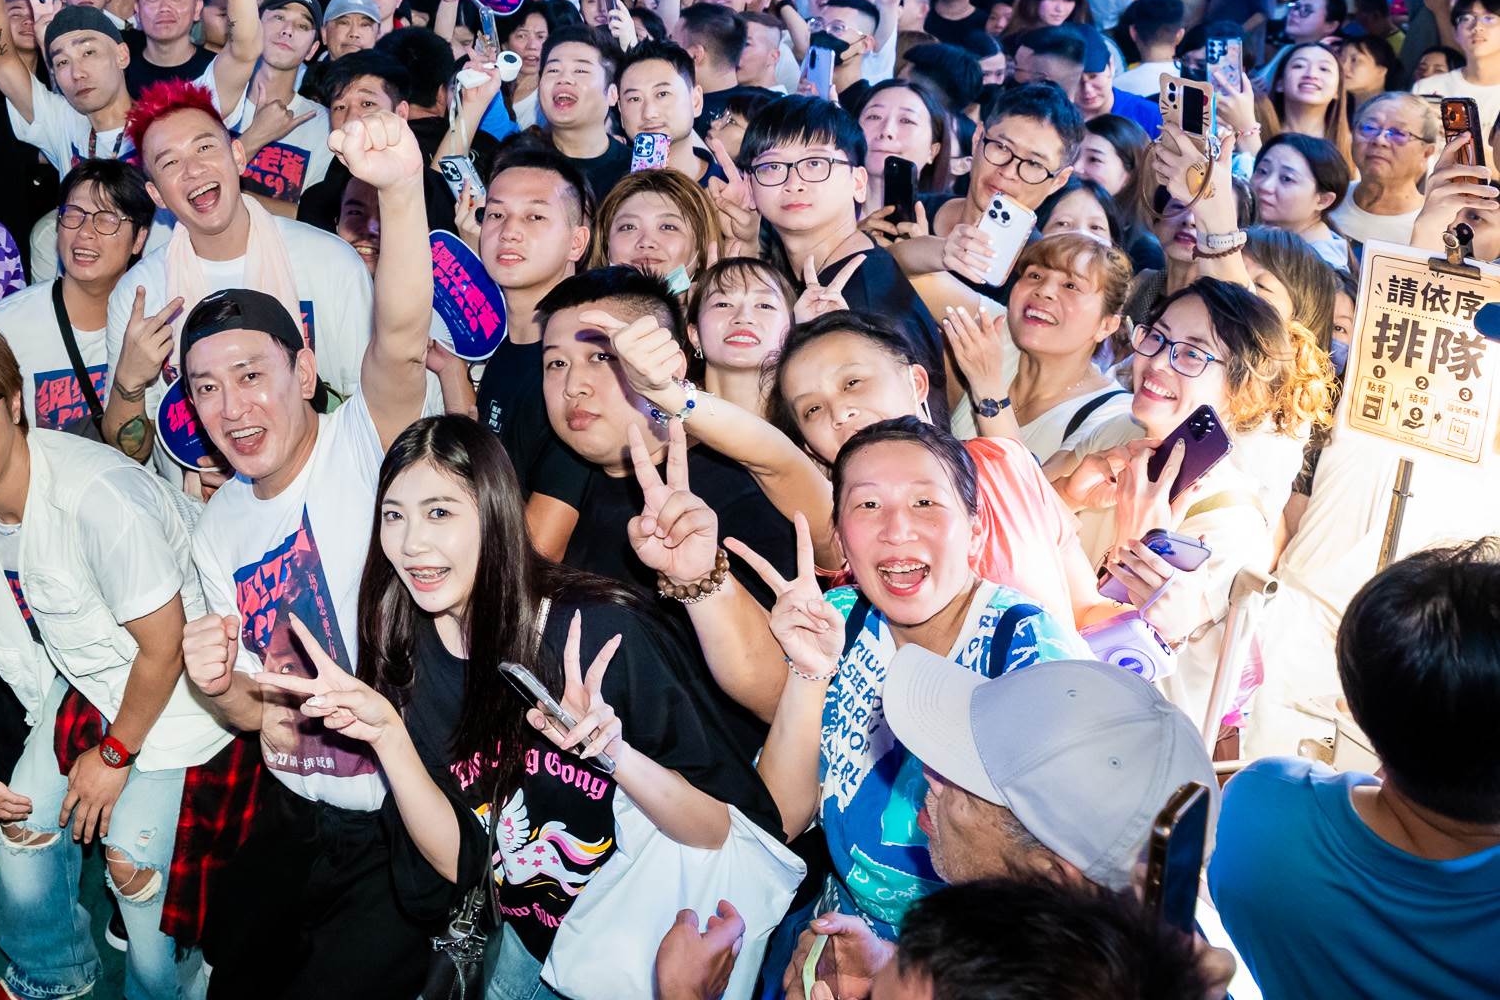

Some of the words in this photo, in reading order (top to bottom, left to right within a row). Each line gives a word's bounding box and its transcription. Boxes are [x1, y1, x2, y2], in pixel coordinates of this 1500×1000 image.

[1387, 274, 1486, 321] 請依序
[1371, 312, 1488, 381] 排隊
